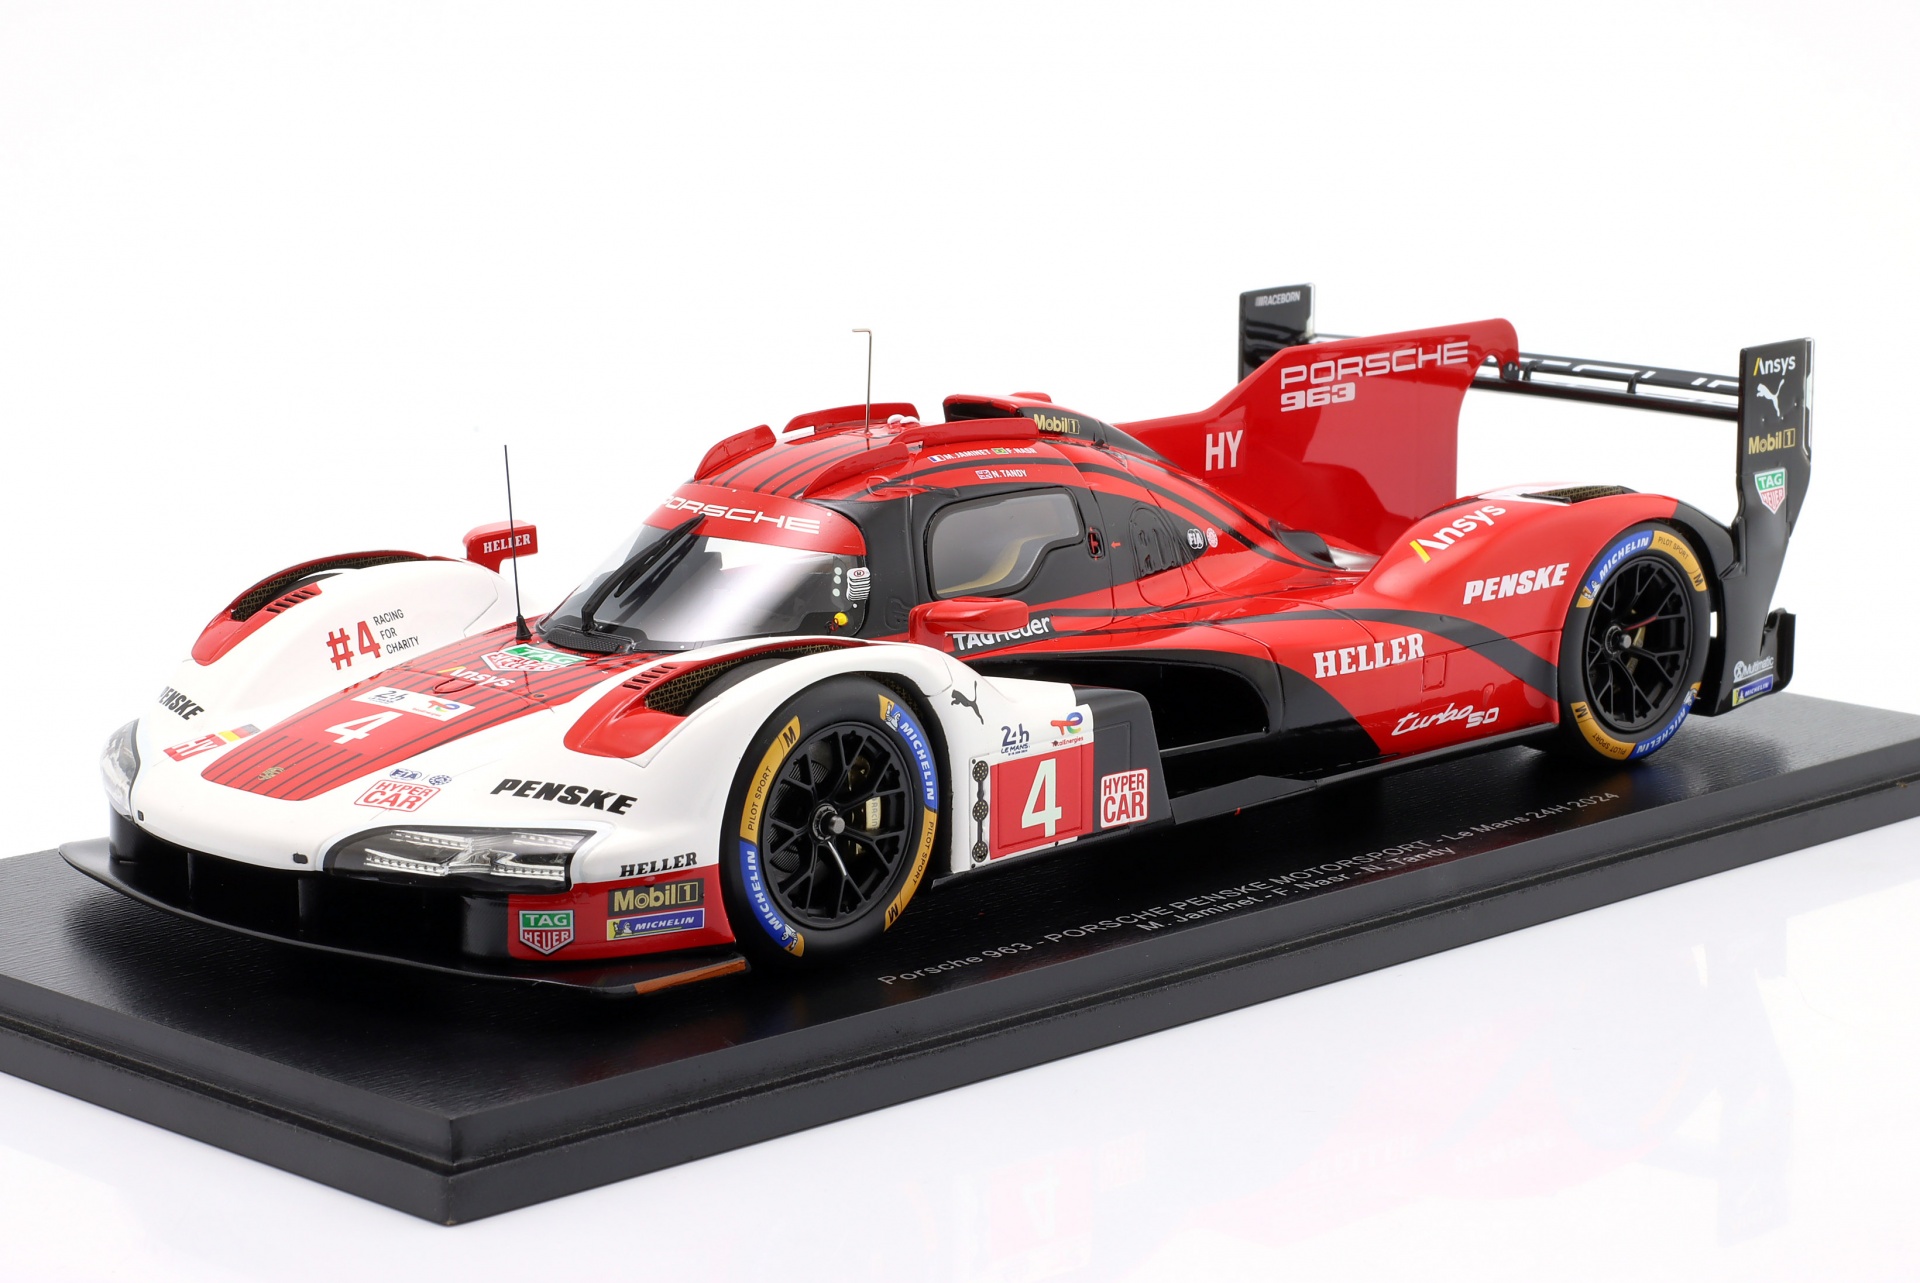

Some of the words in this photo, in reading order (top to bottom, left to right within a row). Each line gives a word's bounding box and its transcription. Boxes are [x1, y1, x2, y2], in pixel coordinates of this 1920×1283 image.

[1263, 291, 1300, 306] RACEBORN
[1280, 341, 1469, 390] PORSCHE
[1753, 356, 1796, 377] Ansys
[1280, 381, 1356, 412] 963
[1033, 413, 1068, 433] Mobil
[1205, 429, 1244, 472] HY
[1748, 431, 1783, 455] Mobil
[991, 469, 1028, 479] N.TANDY
[1758, 473, 1783, 489] TAG
[1761, 490, 1784, 511] HEUER
[483, 533, 531, 554] HELLER
[1409, 504, 1506, 564] Ansys
[1599, 536, 1650, 581] MICHELIN
[1657, 536, 1674, 549] PILOT
[1672, 543, 1690, 561] SPORT
[1463, 562, 1570, 605] PENSKE
[1692, 572, 1704, 587] M
[373, 608, 404, 626] RACING
[326, 620, 381, 671] #4
[380, 627, 397, 640] FOR
[386, 636, 420, 655] CHARITY
[1313, 633, 1425, 679] HELLER
[439, 665, 515, 688] Ansys
[324, 710, 404, 745] 4
[1391, 702, 1474, 736] turbo
[1465, 707, 1500, 729] 50
[1636, 708, 1687, 754] MICHELIN
[782, 726, 797, 748] M
[391, 768, 418, 780] FIA
[900, 721, 935, 801] MICHELIN
[375, 781, 434, 797] HYPER
[490, 778, 638, 816] PENSKE
[747, 801, 759, 831] PILOT
[754, 765, 773, 800] SPORT
[1021, 758, 1062, 838] 4
[1103, 773, 1145, 797] HYPER
[363, 790, 423, 810] CAR
[1103, 791, 1145, 823] CAR
[924, 821, 935, 851] PILOT
[619, 852, 698, 878] HELLER
[911, 850, 928, 886] SPORT
[746, 850, 783, 931] MICHELIN
[878, 953, 983, 985] Porsche
[982, 942, 1033, 959] 963
[1043, 906, 1164, 943] PORSCHE
[1167, 880, 1272, 912] PENSKE
[1269, 839, 1432, 885] MOTORSPORT
[1444, 828, 1474, 841] Le
[1470, 814, 1530, 834] Mans
[1526, 803, 1571, 820] 24H
[1567, 790, 1620, 808] 2024
[1173, 895, 1264, 923] Jaminet
[1295, 872, 1352, 891] Nasr
[1388, 845, 1455, 868] Tandy
[613, 883, 677, 912] Mobil
[525, 914, 568, 927] TAG
[634, 916, 695, 931] MICHELIN
[524, 931, 569, 951] HEUER
